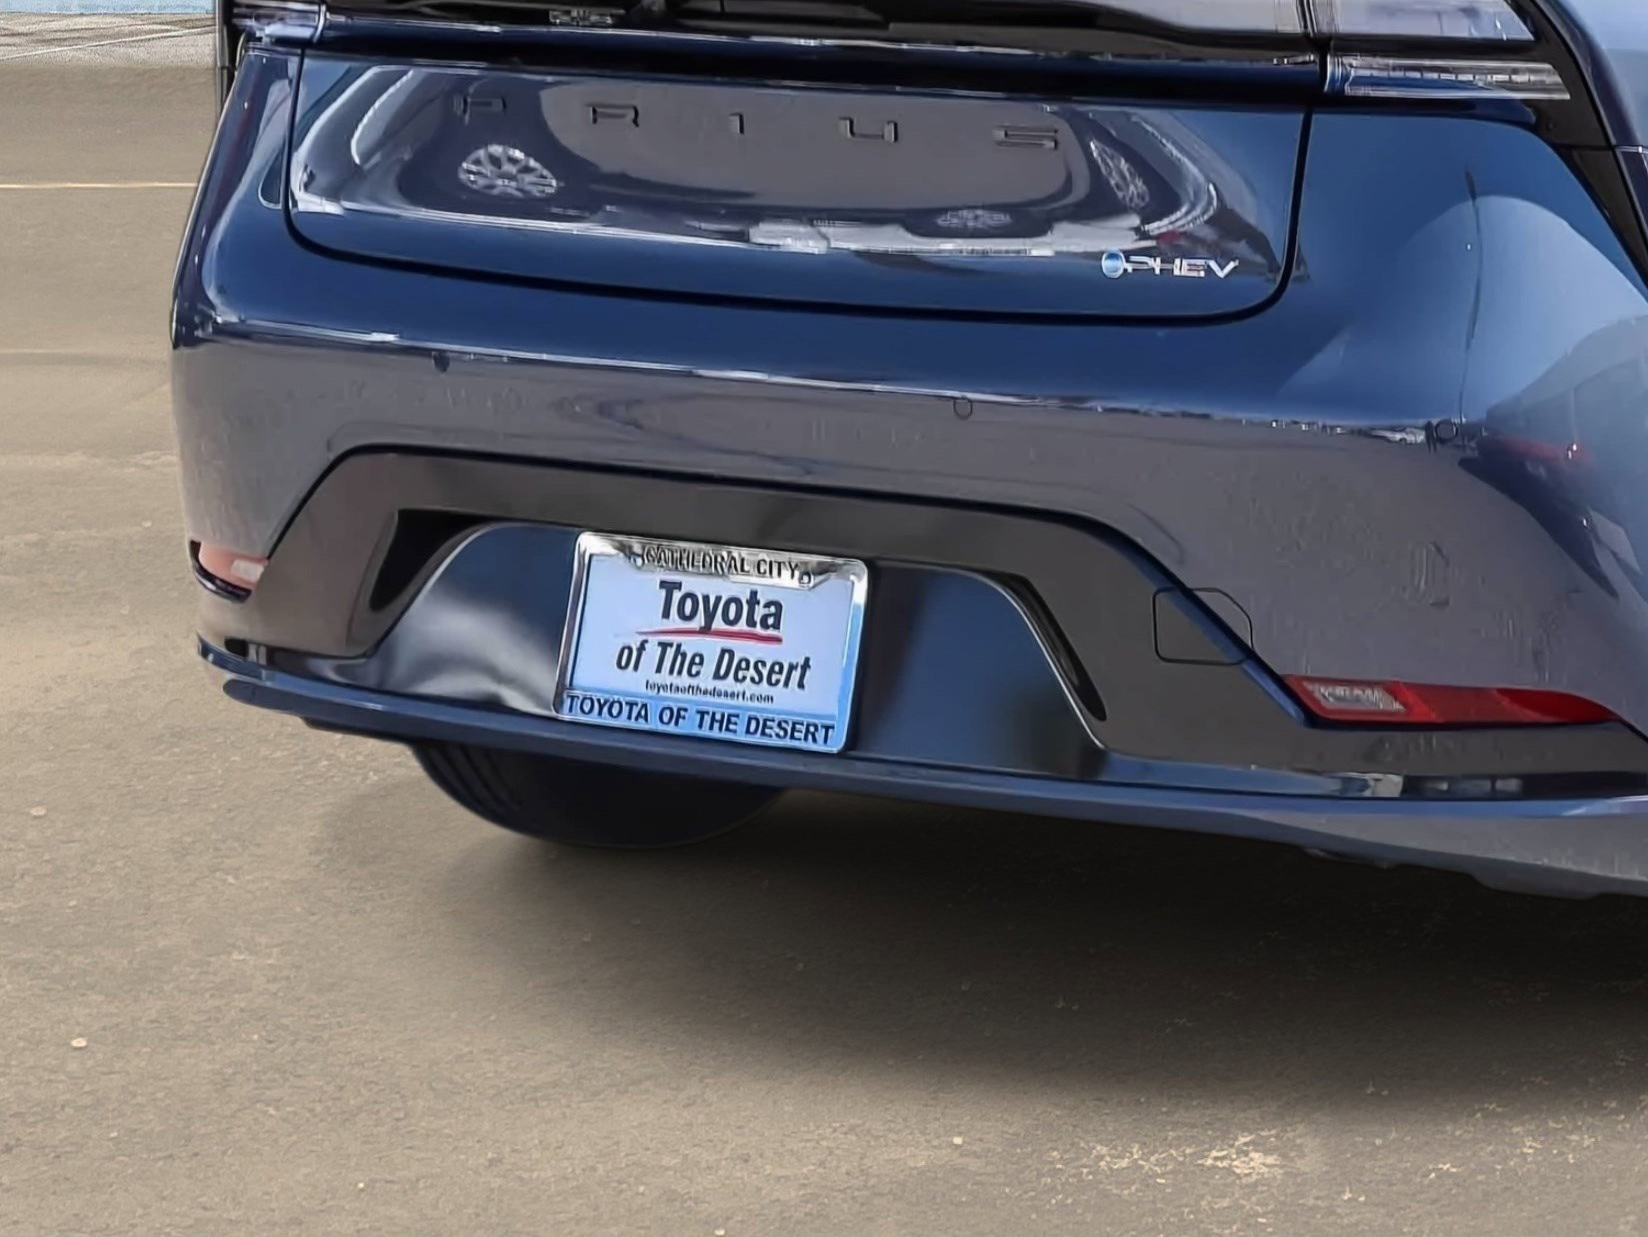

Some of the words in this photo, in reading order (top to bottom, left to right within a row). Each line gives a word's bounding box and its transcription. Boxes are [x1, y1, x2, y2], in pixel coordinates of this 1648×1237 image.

[756, 558, 800, 580] CITY
[658, 579, 784, 633] Toyota
[615, 639, 647, 673] of
[654, 641, 705, 682] The
[712, 648, 812, 691] Desert
[645, 679, 775, 705] toyotaofthedesert.com
[565, 694, 649, 724] TOYOTA
[658, 706, 689, 727] OF
[695, 710, 740, 735] THE
[744, 717, 836, 746] DESERT
